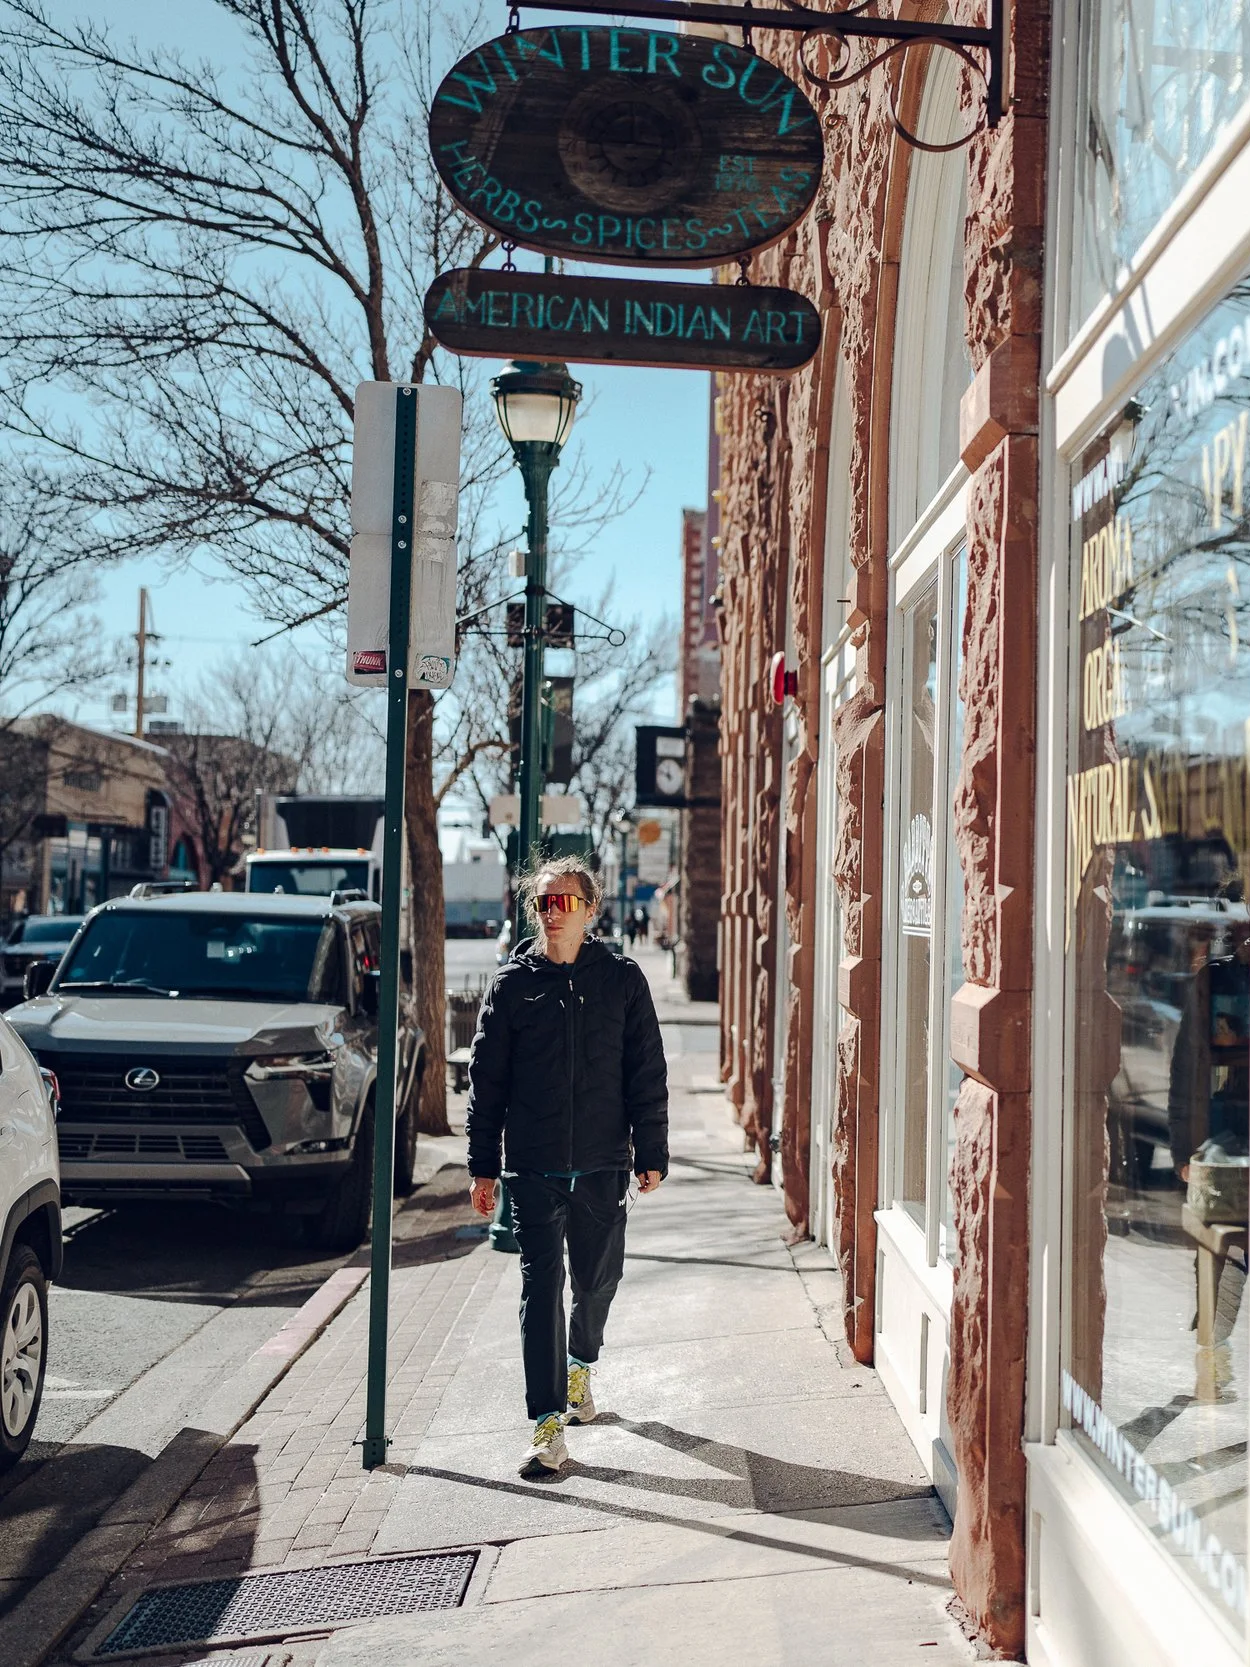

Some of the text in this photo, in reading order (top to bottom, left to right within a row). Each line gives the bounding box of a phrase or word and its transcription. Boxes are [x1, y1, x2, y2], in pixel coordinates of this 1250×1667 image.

[440, 27, 815, 137] WINTER SUN
[719, 155, 757, 173] EST
[433, 288, 810, 345] AMERICAN INDIAN ART
[1065, 756, 1137, 955] NATURAL
